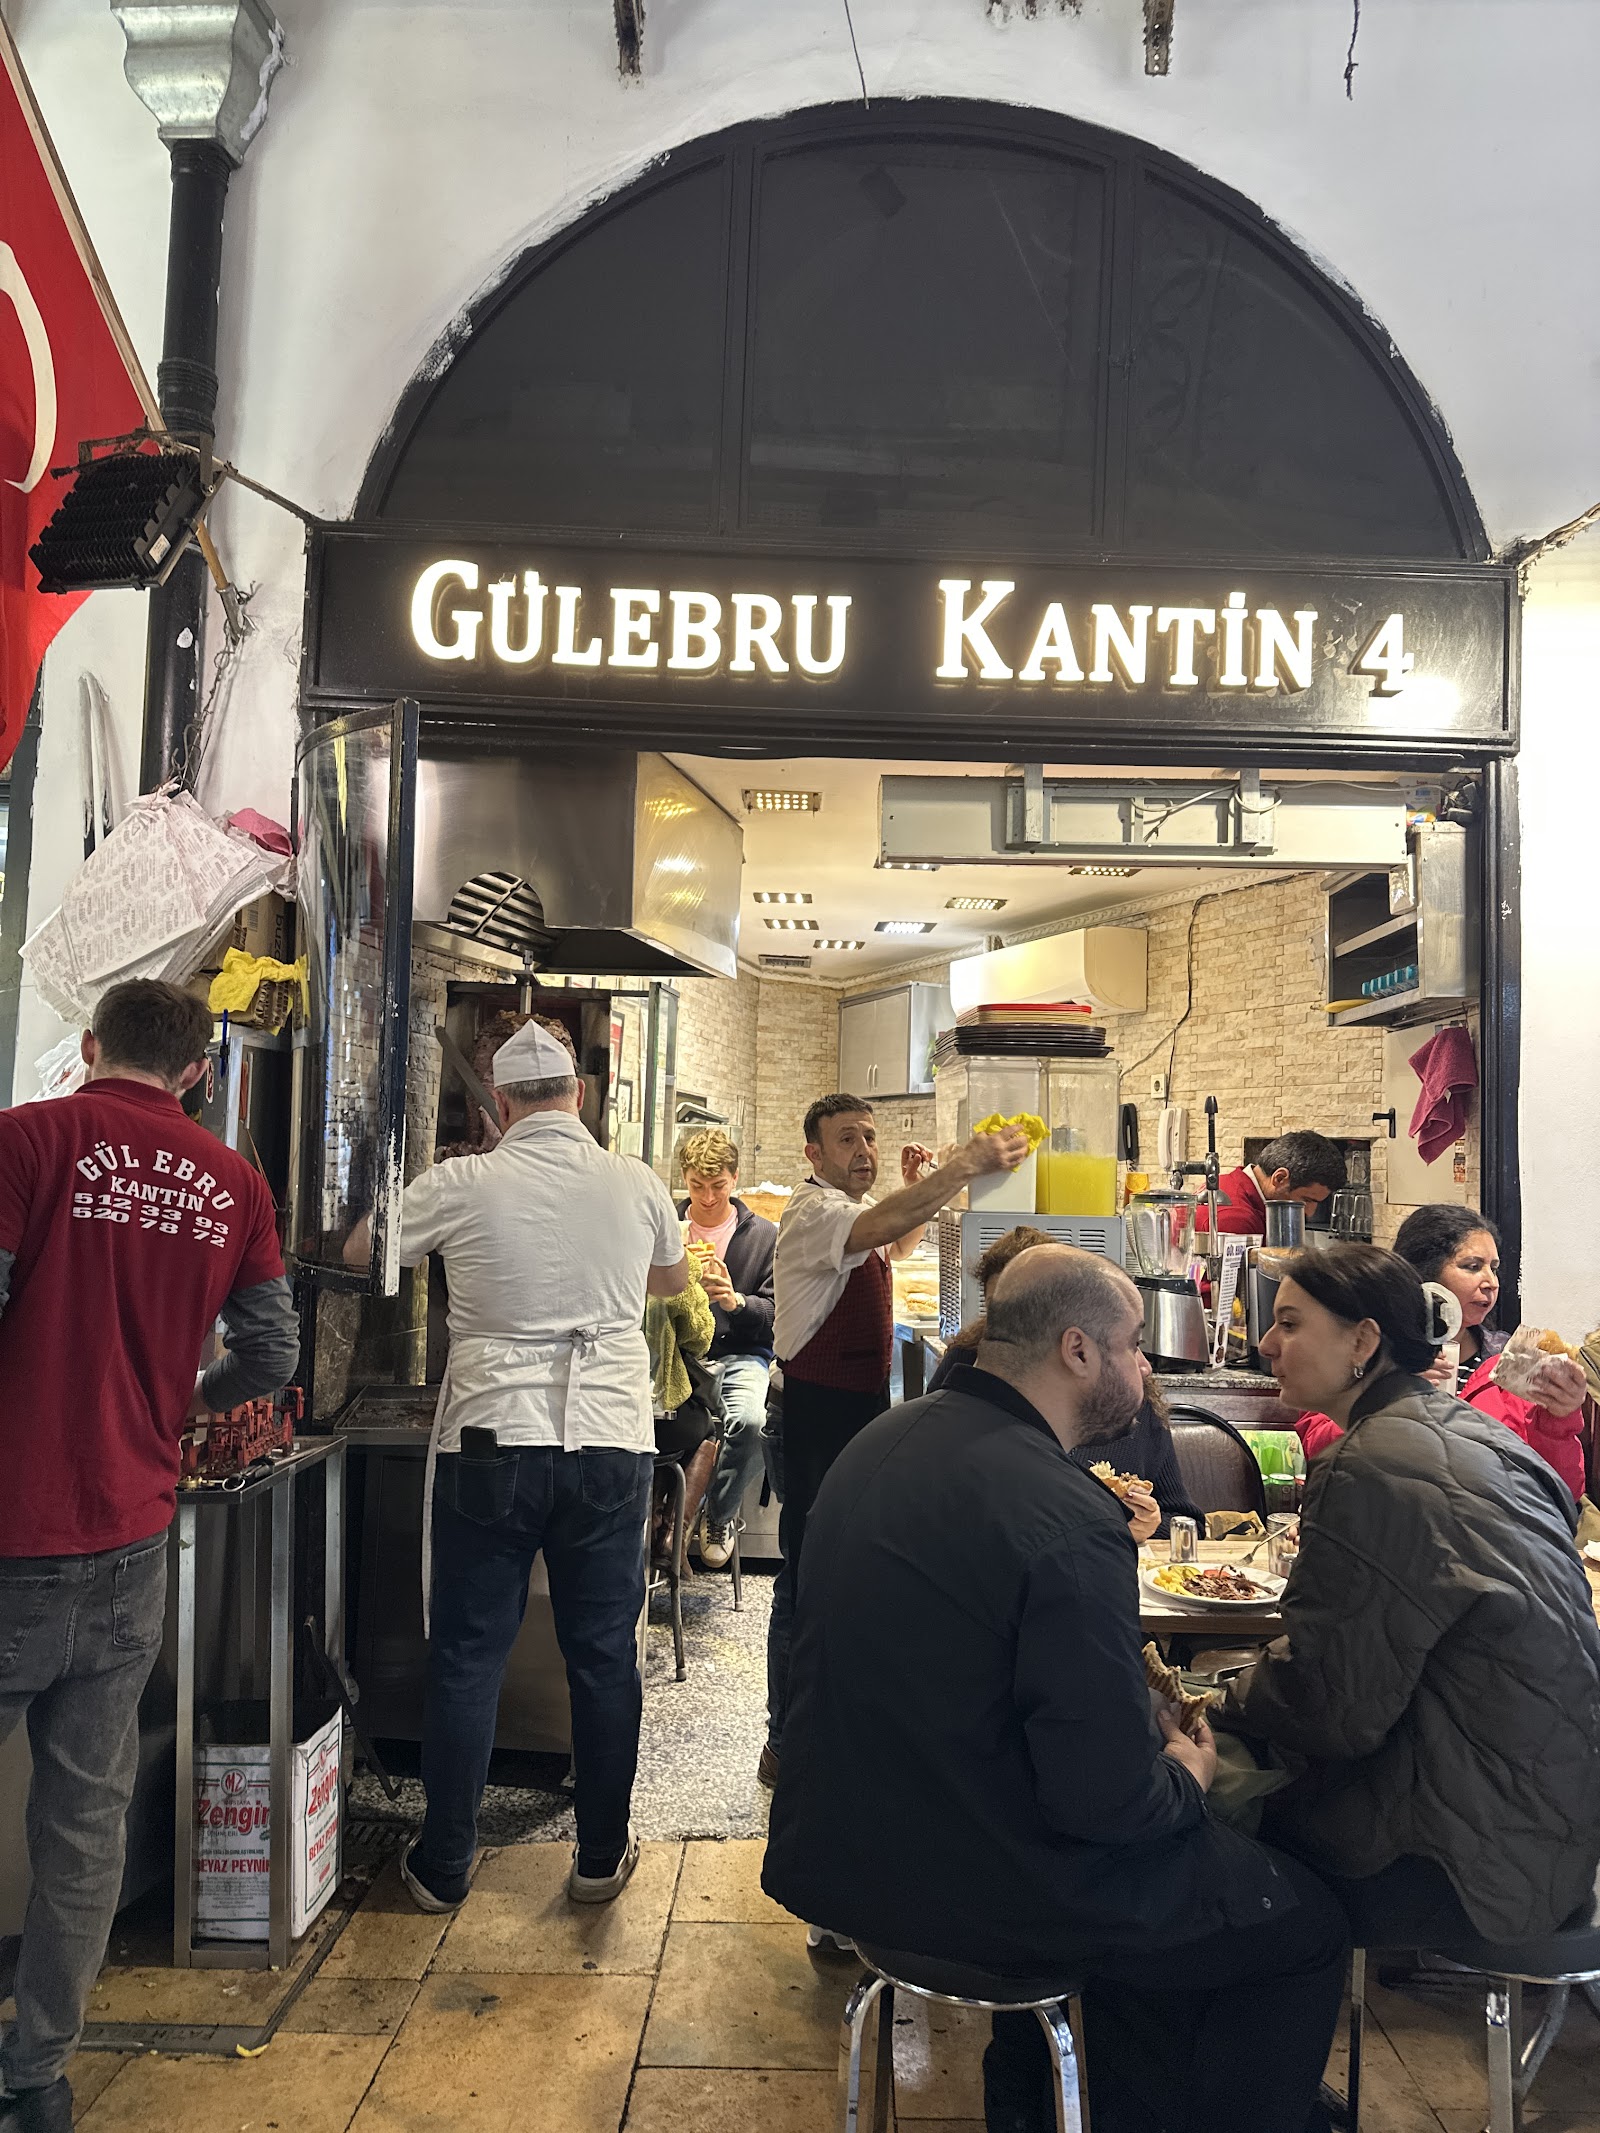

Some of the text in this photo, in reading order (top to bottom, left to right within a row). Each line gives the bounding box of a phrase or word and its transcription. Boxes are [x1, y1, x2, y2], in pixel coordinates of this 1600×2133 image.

[410, 558, 1414, 693] GÜLEBRU KANTİN 4
[76, 1141, 235, 1211] GÜL EBRU
[110, 1175, 205, 1213] KANTİN
[72, 1206, 226, 1249] 520 78 72
[74, 1192, 229, 1235] 512 33 93
[225, 1771, 243, 1793] MZ
